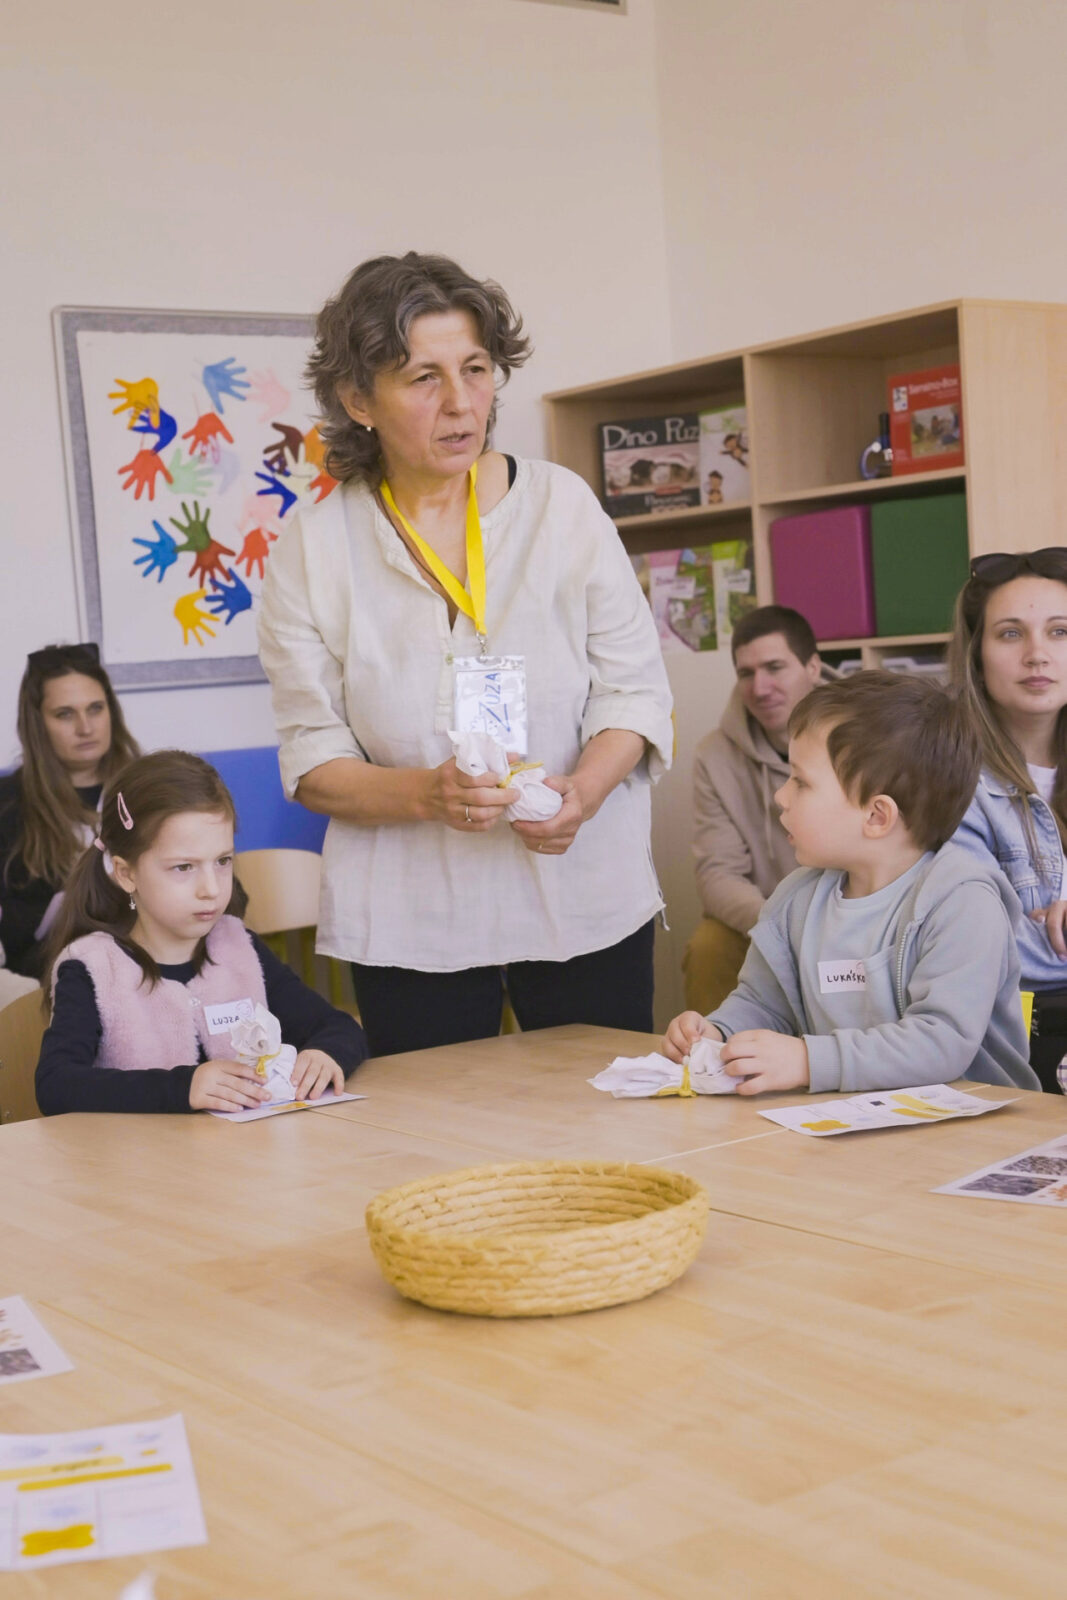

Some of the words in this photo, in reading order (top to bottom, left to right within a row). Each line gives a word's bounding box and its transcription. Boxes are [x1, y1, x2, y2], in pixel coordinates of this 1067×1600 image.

[602, 425, 658, 450] Dino
[665, 418, 700, 442] Puz
[478, 672, 511, 732] ZUZA
